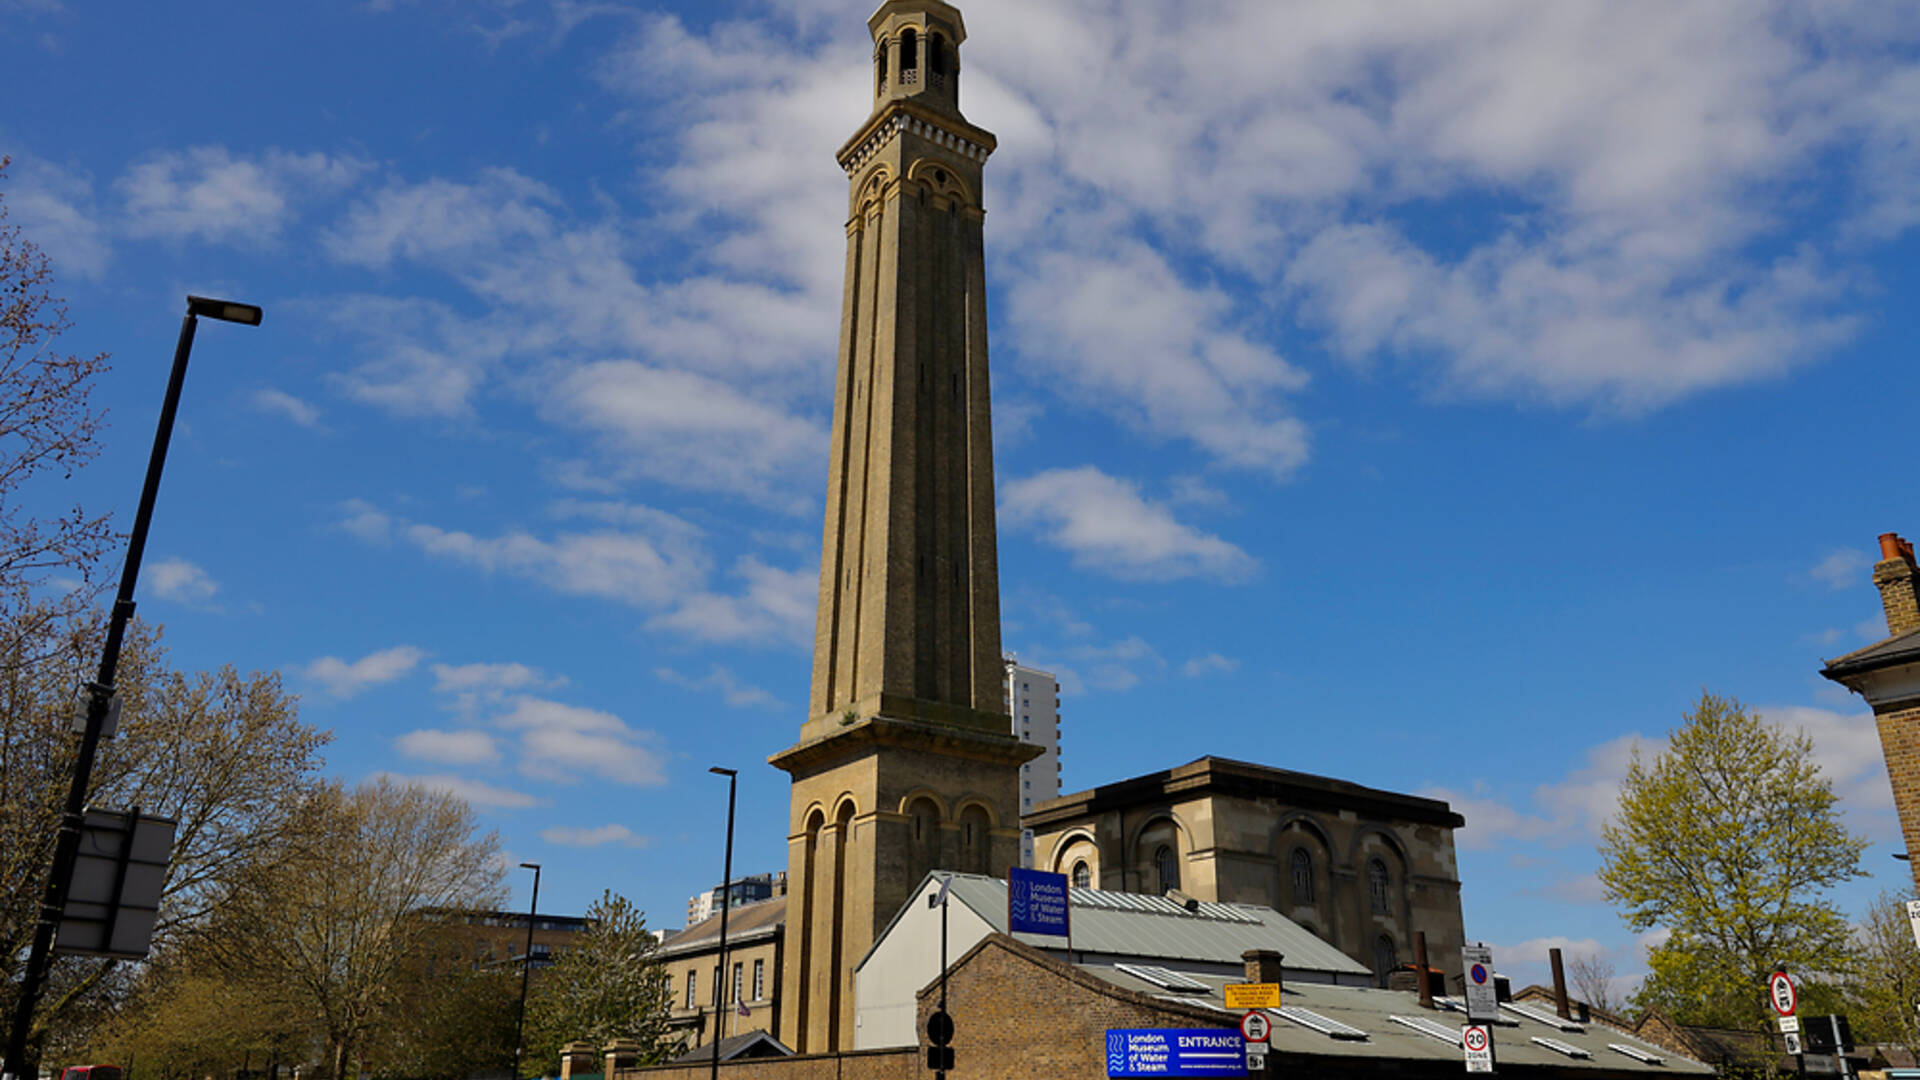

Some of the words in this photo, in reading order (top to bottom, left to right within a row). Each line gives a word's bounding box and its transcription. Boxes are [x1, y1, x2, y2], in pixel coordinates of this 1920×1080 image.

[1030, 881, 1062, 895] London
[1030, 892, 1065, 904] Museum
[1030, 902, 1039, 912] of
[1041, 904, 1064, 914] Water
[1038, 912, 1064, 925] Steam
[1128, 1033, 1164, 1043] London
[1178, 1036, 1241, 1047] ENTRANCE
[1468, 1034, 1484, 1045] 20
[1129, 1044, 1169, 1052] Museum
[1129, 1054, 1138, 1062] of
[1140, 1054, 1168, 1062] Water
[1129, 1062, 1135, 1072] &
[1136, 1062, 1167, 1072] Steam
